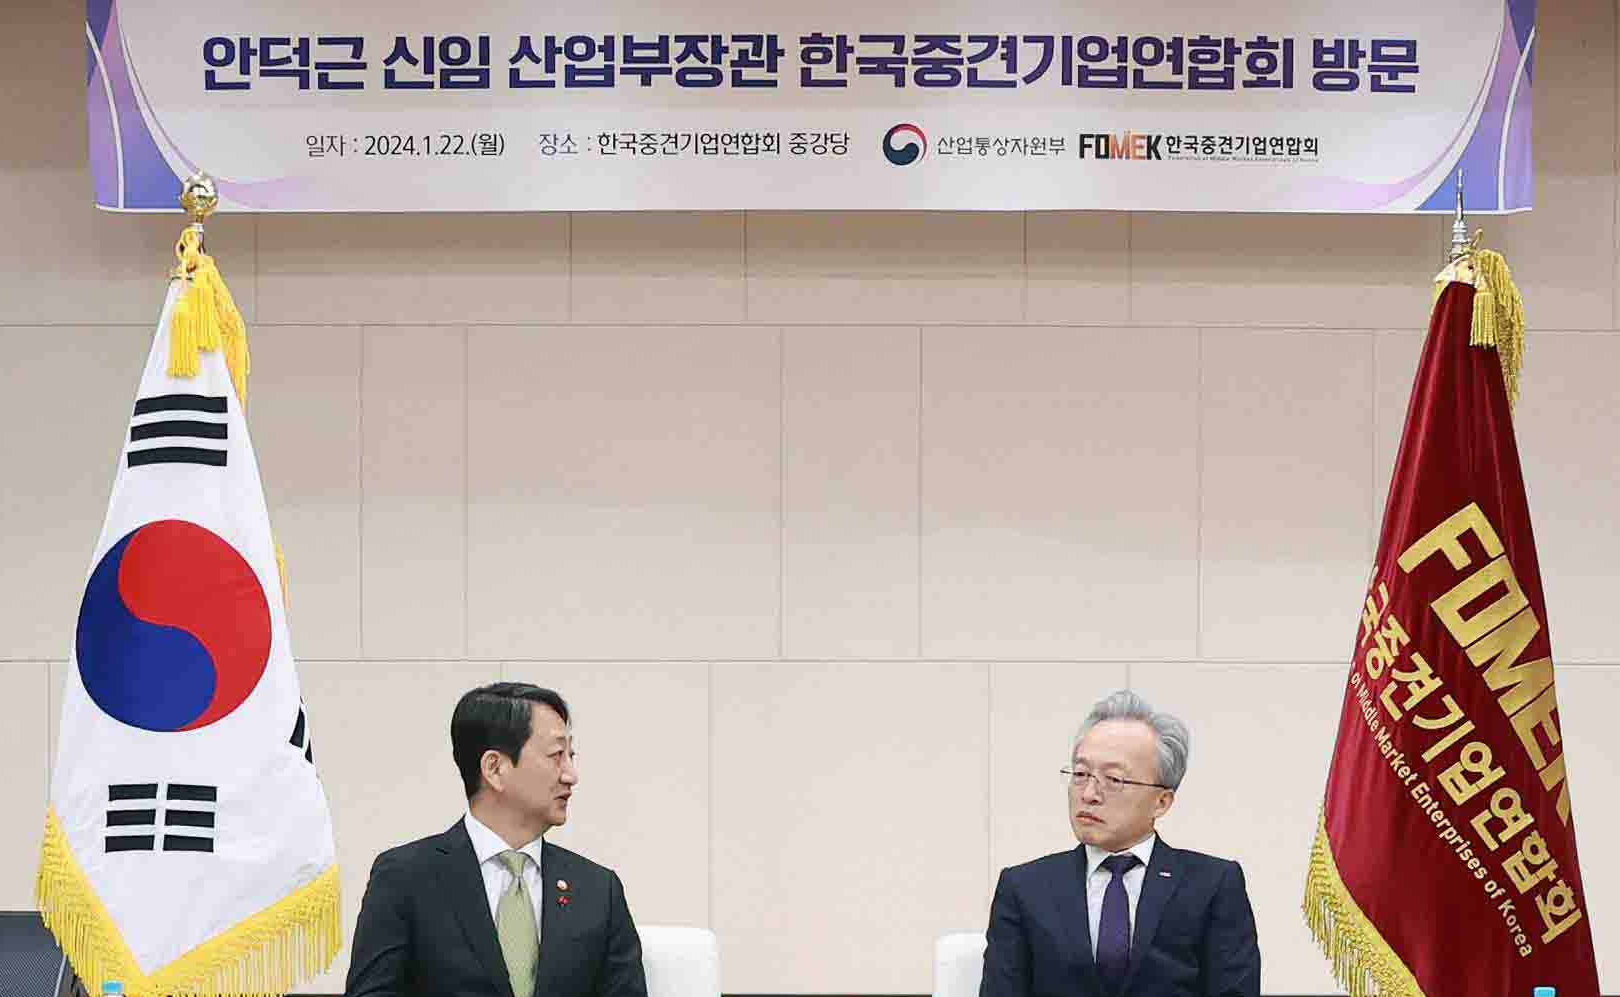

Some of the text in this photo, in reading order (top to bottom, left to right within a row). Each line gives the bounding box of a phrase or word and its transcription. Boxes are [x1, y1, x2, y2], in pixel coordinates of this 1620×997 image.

[202, 31, 1420, 94] 안덕근 신임 산업부장관 한국중견기업연합회 방문
[305, 133, 347, 158] 일자
[364, 132, 506, 158] 2024.1.22.(월)
[538, 132, 580, 157] 장소
[596, 131, 781, 157] 한국중견기업연합회
[788, 131, 851, 156] 중강당
[936, 135, 1067, 157] 산업통상자원부
[1078, 131, 1320, 161] FOMEK 한국중견기업연합회
[1359, 562, 1583, 945] 국중견기업연합회
[1356, 682, 1380, 733] Middle
[1374, 725, 1419, 786] Market
[1411, 780, 1488, 880] Enterprises
[1483, 879, 1506, 900] of
[1497, 897, 1534, 958] Korea
